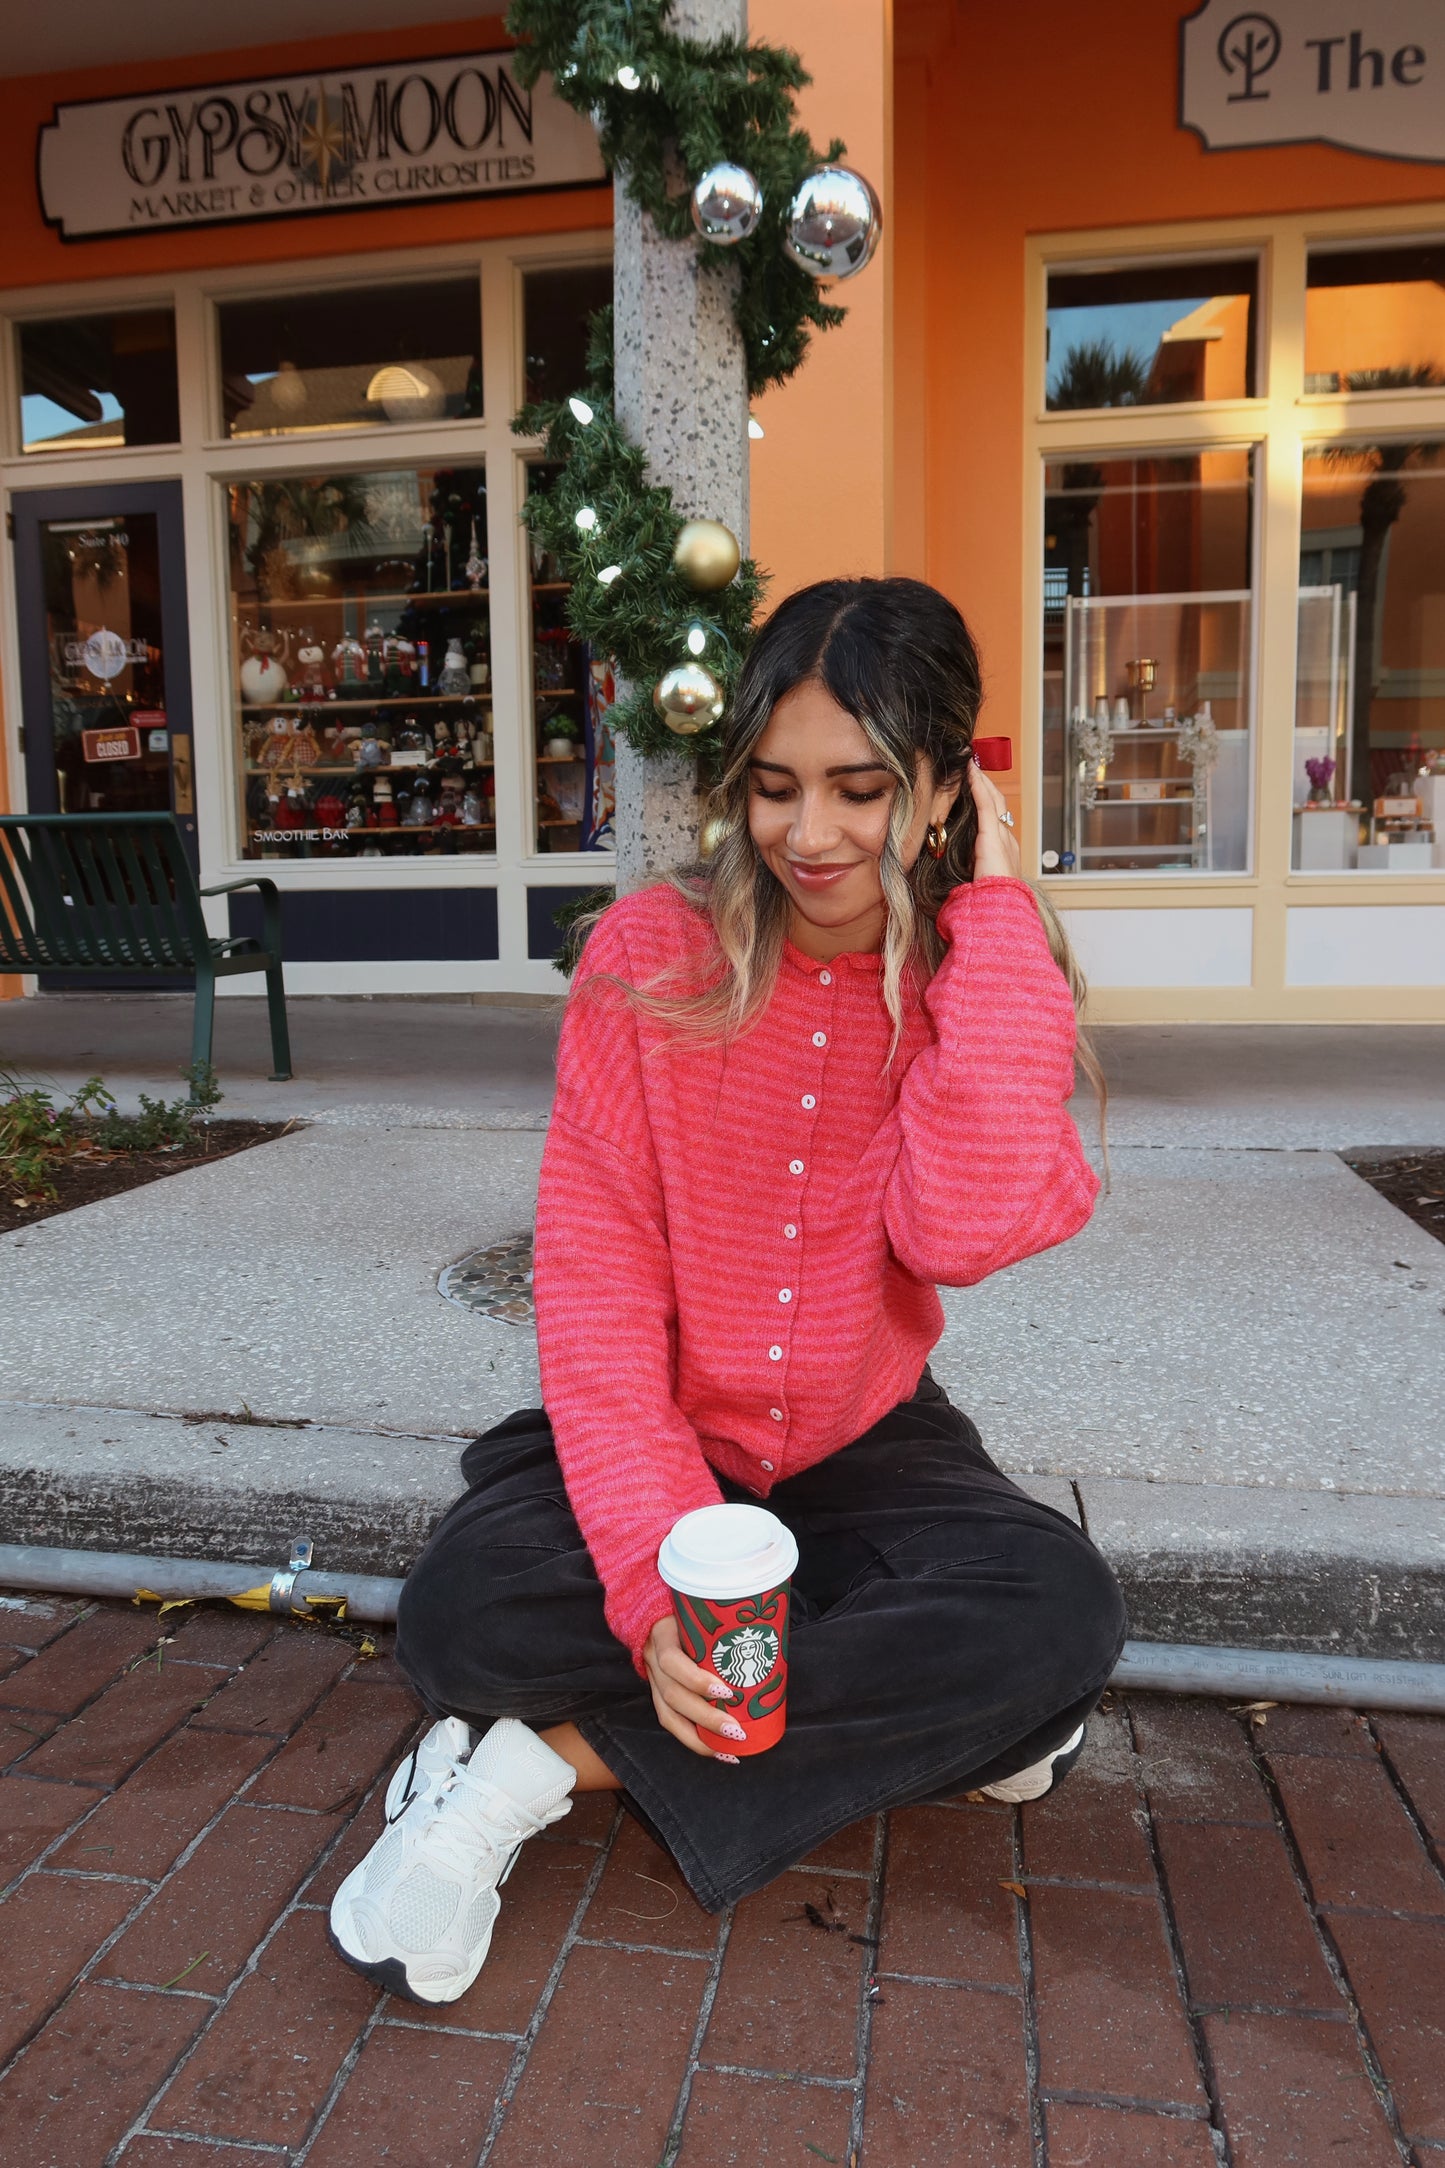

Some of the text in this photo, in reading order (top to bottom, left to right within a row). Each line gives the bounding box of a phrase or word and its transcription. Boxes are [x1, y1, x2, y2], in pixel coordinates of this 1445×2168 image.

[1304, 29, 1426, 93] The
[121, 65, 533, 188] GYPSY MOON
[129, 186, 241, 222] MARKET
[249, 182, 266, 208] &
[374, 155, 535, 193] CURIOSITIES
[96, 740, 129, 757] CLOSED
[253, 827, 349, 842] SMOOTHIE BAR
